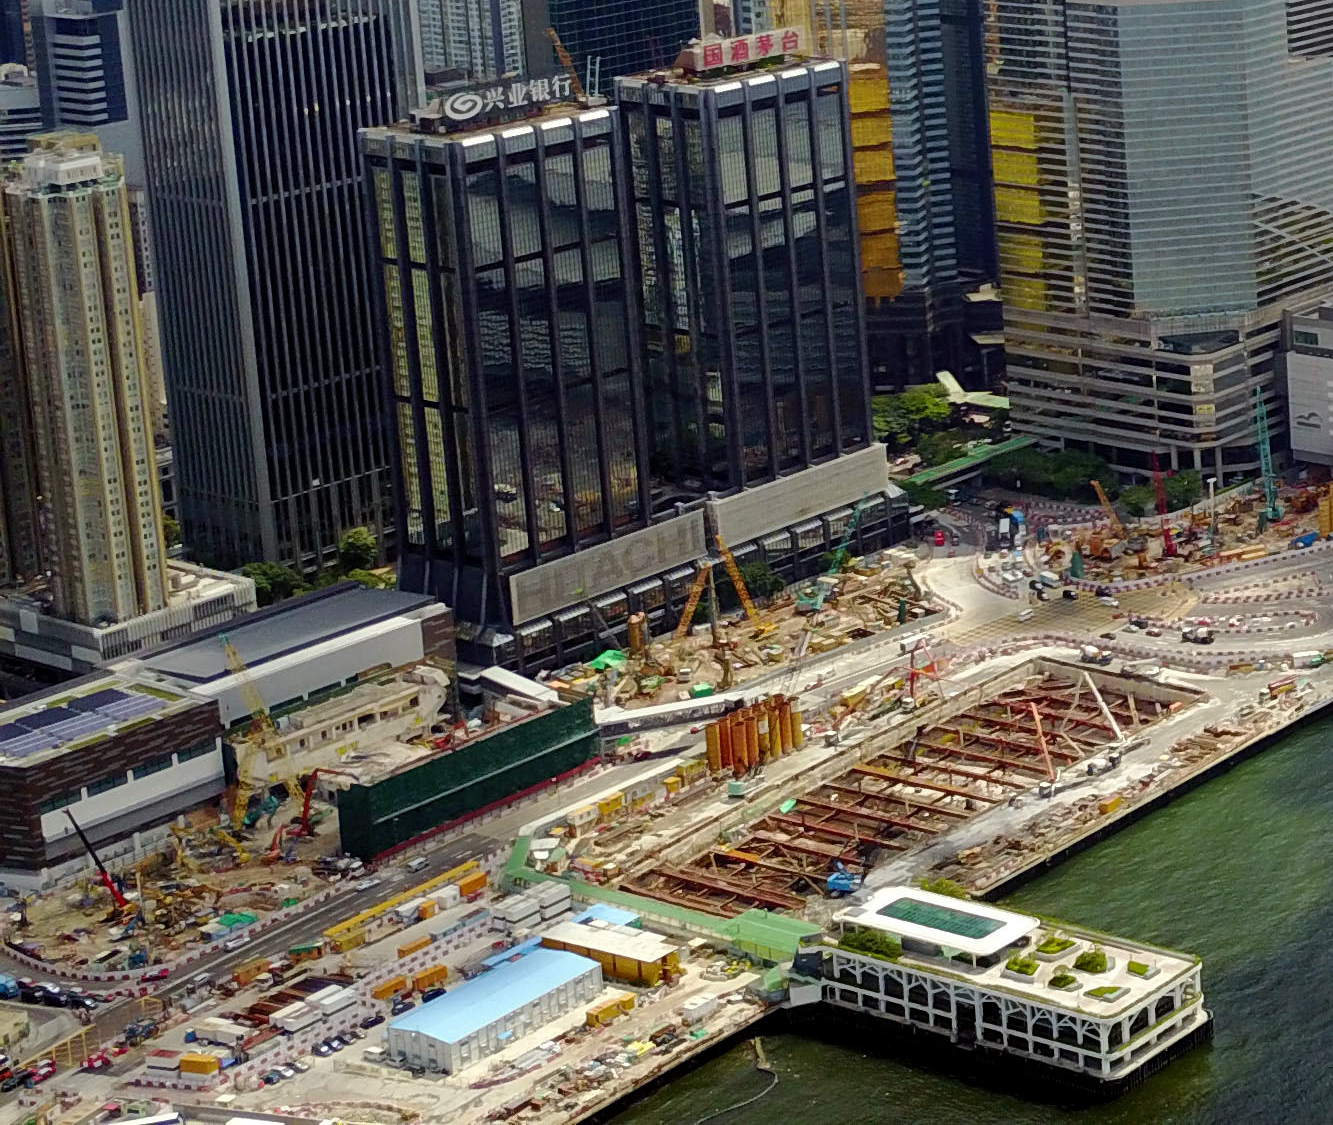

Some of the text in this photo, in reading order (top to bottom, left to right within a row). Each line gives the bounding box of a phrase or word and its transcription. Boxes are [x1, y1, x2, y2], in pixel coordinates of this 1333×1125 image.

[703, 30, 799, 67] 国酒茅台
[483, 74, 572, 113] 兴业银行
